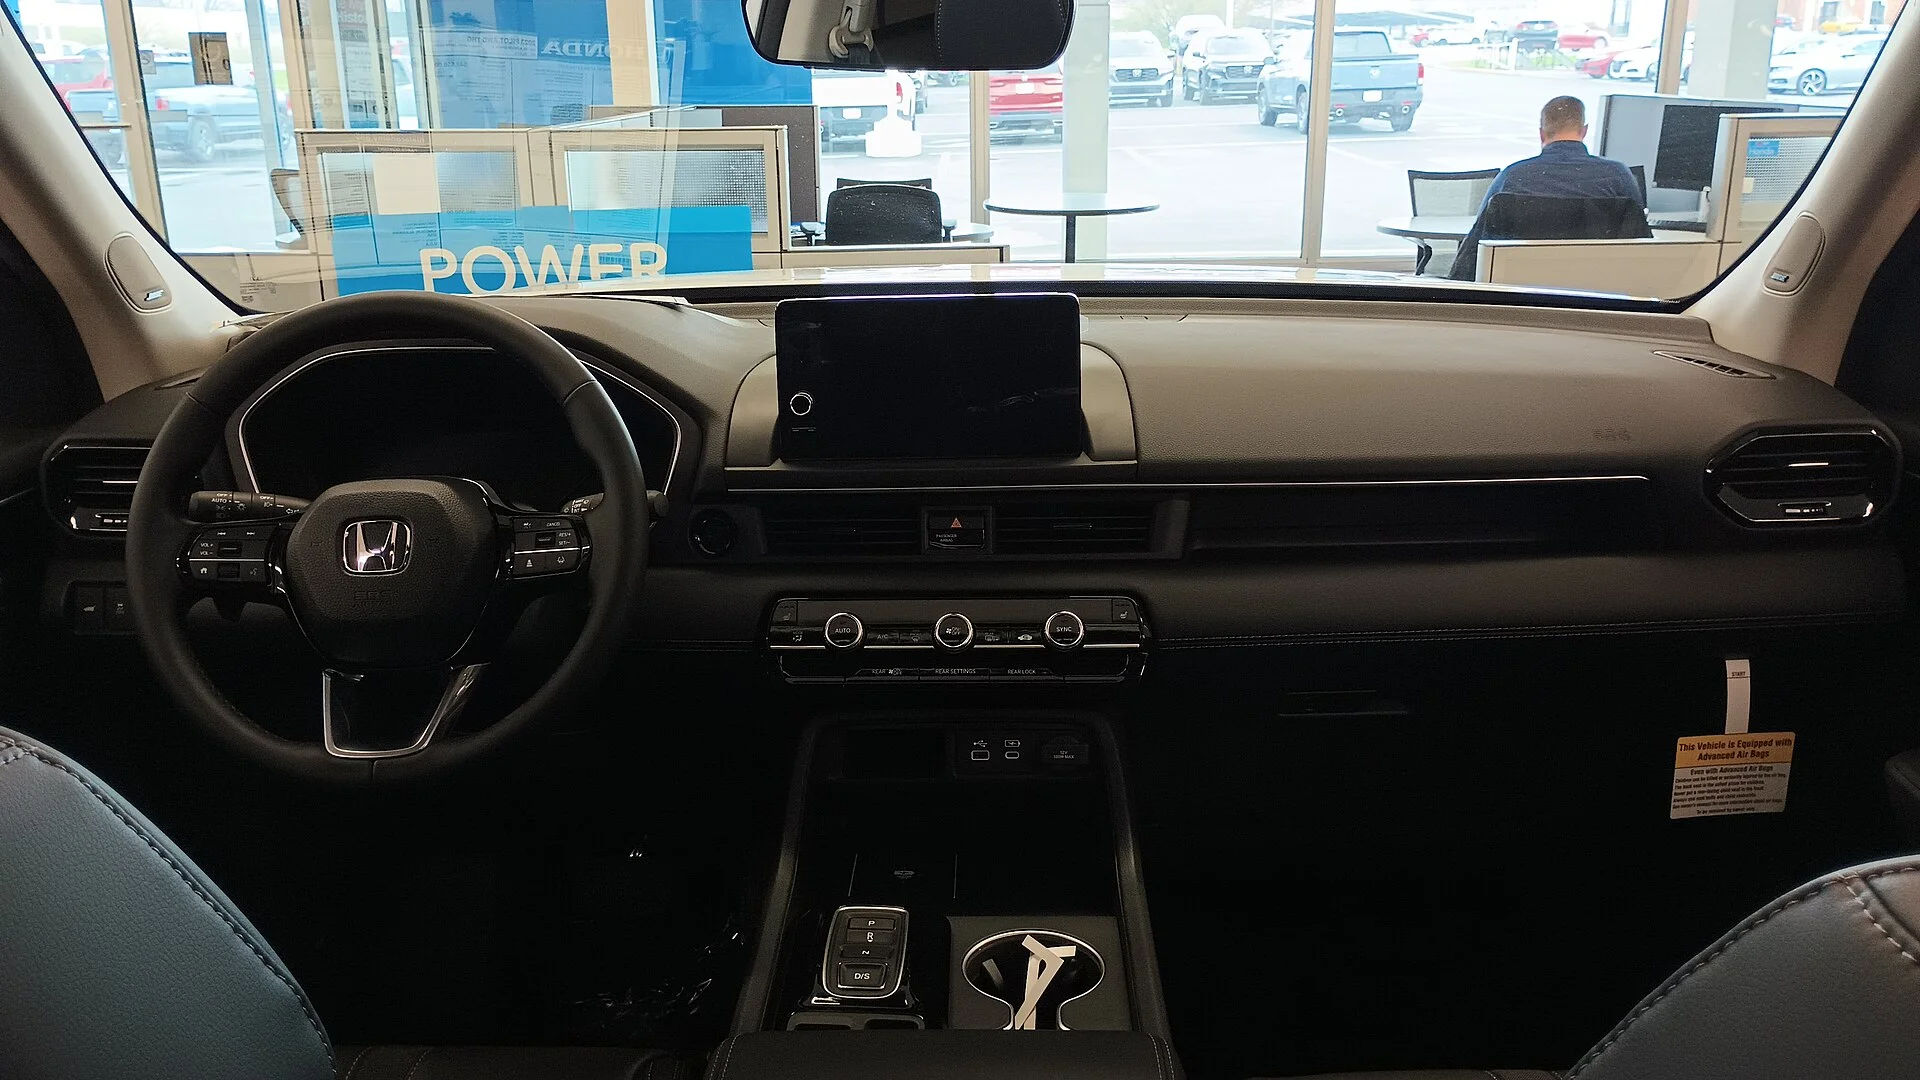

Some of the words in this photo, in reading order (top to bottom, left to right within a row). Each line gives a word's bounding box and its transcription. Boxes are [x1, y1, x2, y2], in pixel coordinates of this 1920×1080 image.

[420, 243, 667, 294] POWER
[1679, 743, 1695, 752] This
[1697, 741, 1726, 751] Vehicle
[1737, 739, 1774, 750] Equipped
[1775, 738, 1792, 747] with
[1697, 751, 1735, 761] Advanced
[1737, 750, 1748, 759] Air
[1750, 749, 1770, 760] Bags
[1759, 765, 1774, 773] Bags
[867, 932, 874, 940] R
